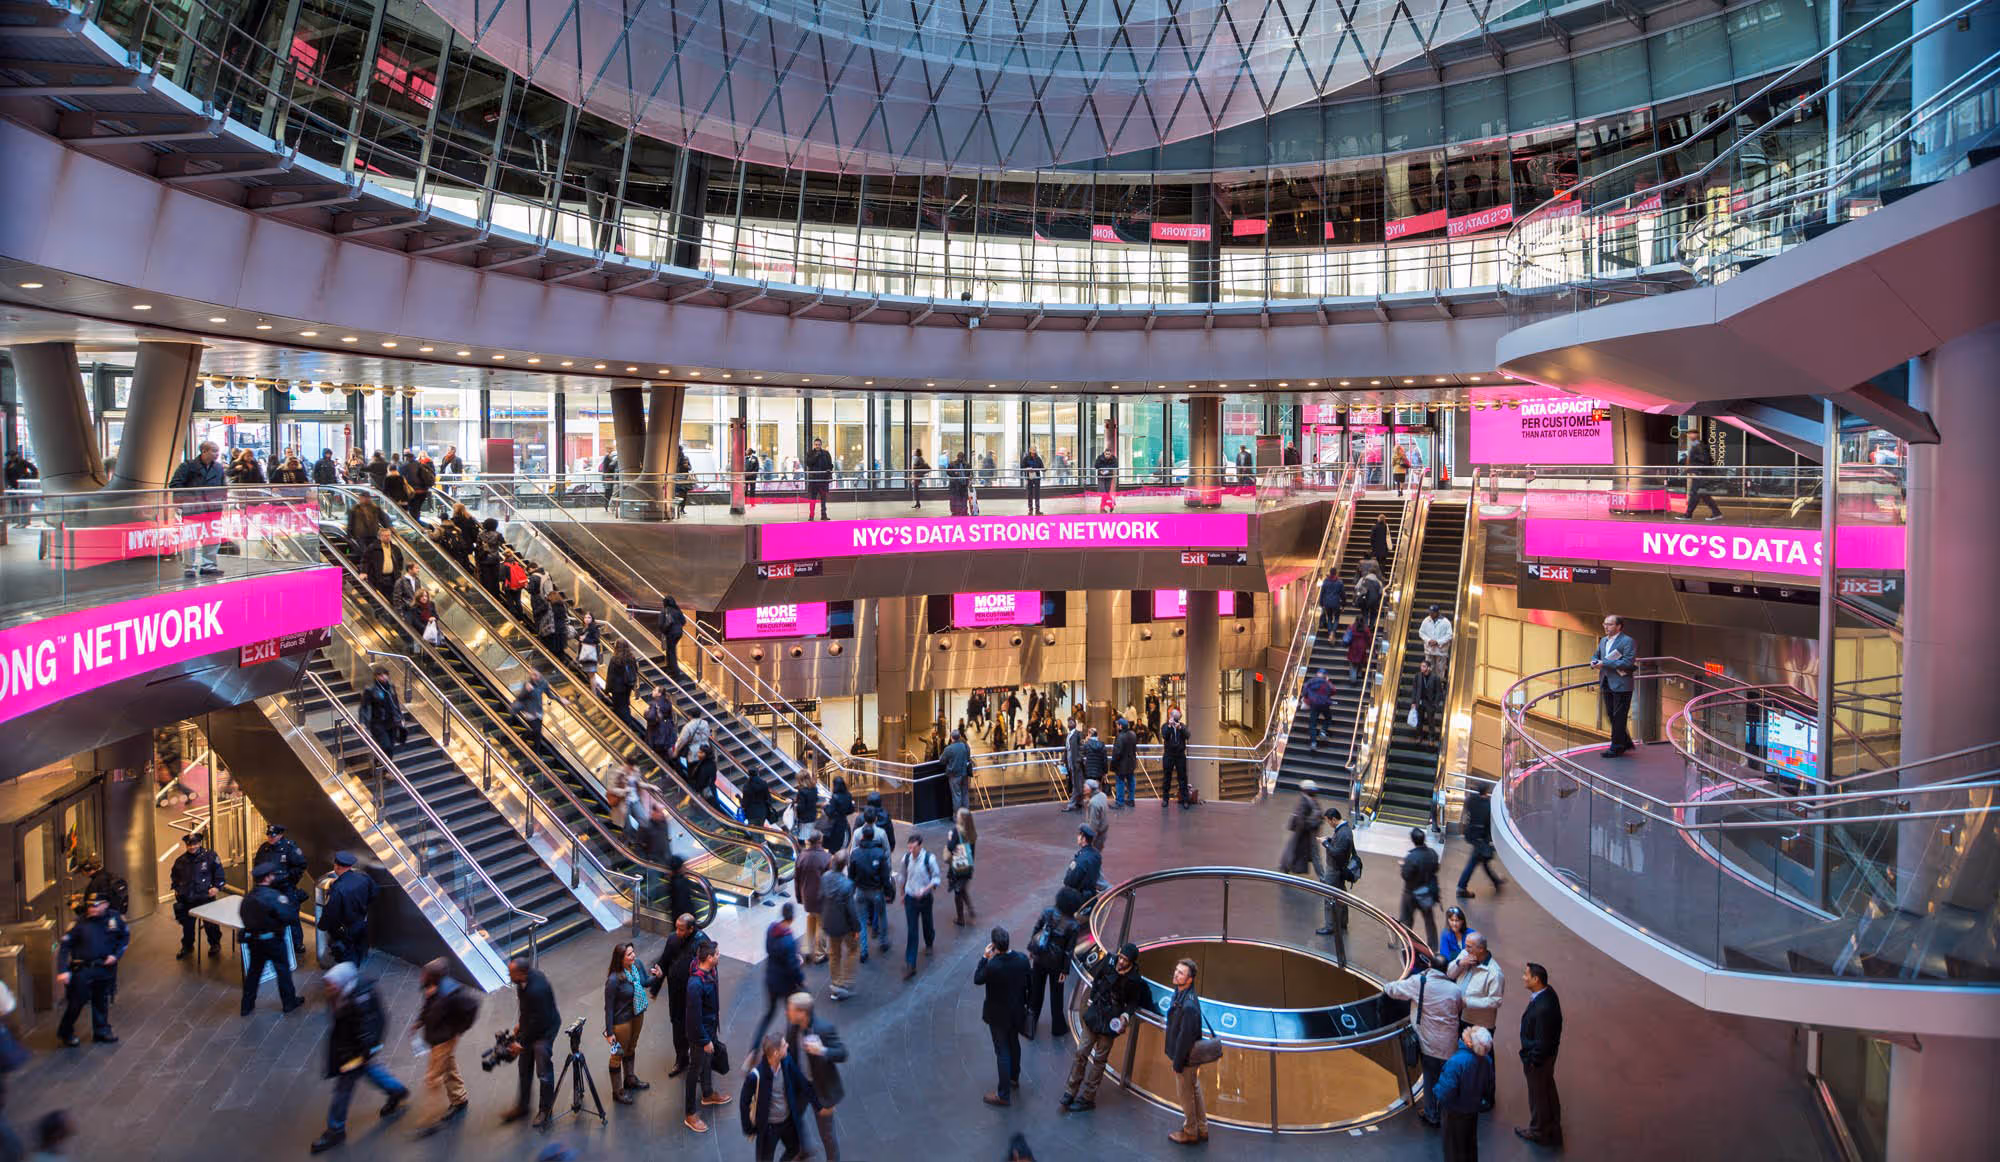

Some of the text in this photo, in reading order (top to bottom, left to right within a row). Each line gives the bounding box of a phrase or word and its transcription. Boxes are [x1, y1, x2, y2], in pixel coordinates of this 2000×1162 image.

[1521, 404, 1546, 416] DATA
[1522, 416, 1541, 428] PER
[1522, 428, 1600, 438] THAN AT&T OR VERIZON
[853, 526, 912, 547] NYC'S
[916, 524, 965, 544] DATA
[1059, 521, 1159, 540] NETWORK
[1642, 531, 1726, 558] NYC'S
[1732, 537, 1808, 565] DATA
[1181, 552, 1205, 564] Exit
[768, 563, 791, 577] Exit
[1540, 565, 1568, 580] Exit
[974, 594, 1016, 608] MORE
[756, 604, 797, 618] MORE
[73, 600, 224, 675] NETWORK
[241, 639, 276, 664] Exit
